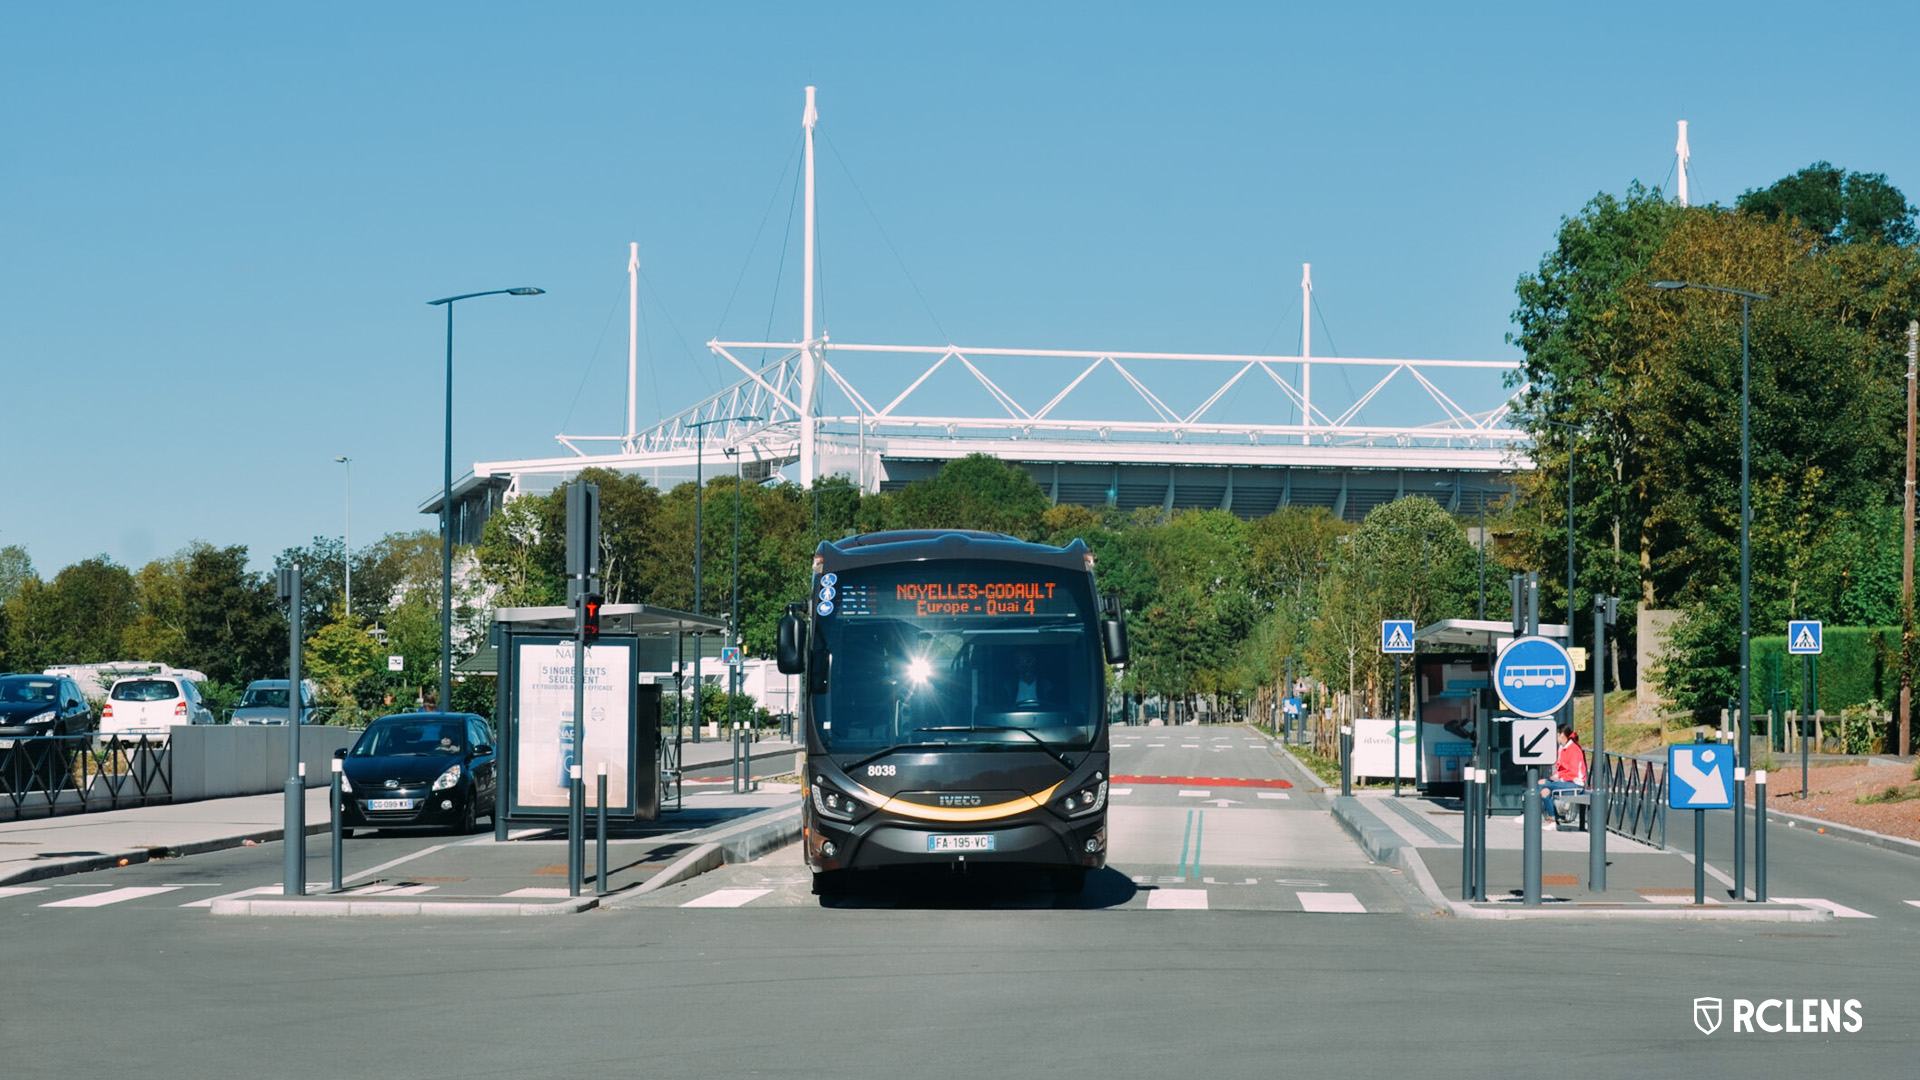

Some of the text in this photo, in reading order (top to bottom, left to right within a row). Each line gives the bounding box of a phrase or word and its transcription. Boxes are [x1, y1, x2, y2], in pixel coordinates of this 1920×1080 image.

[896, 583, 1056, 600] NOYELLES-GODAULT
[917, 600, 969, 615] Europe
[986, 599, 1019, 615] Quai
[1023, 599, 1035, 615] 4
[542, 666, 548, 675] 5
[548, 675, 599, 684] SEULEENT
[868, 765, 897, 776] 8038
[939, 795, 982, 806] IVECO
